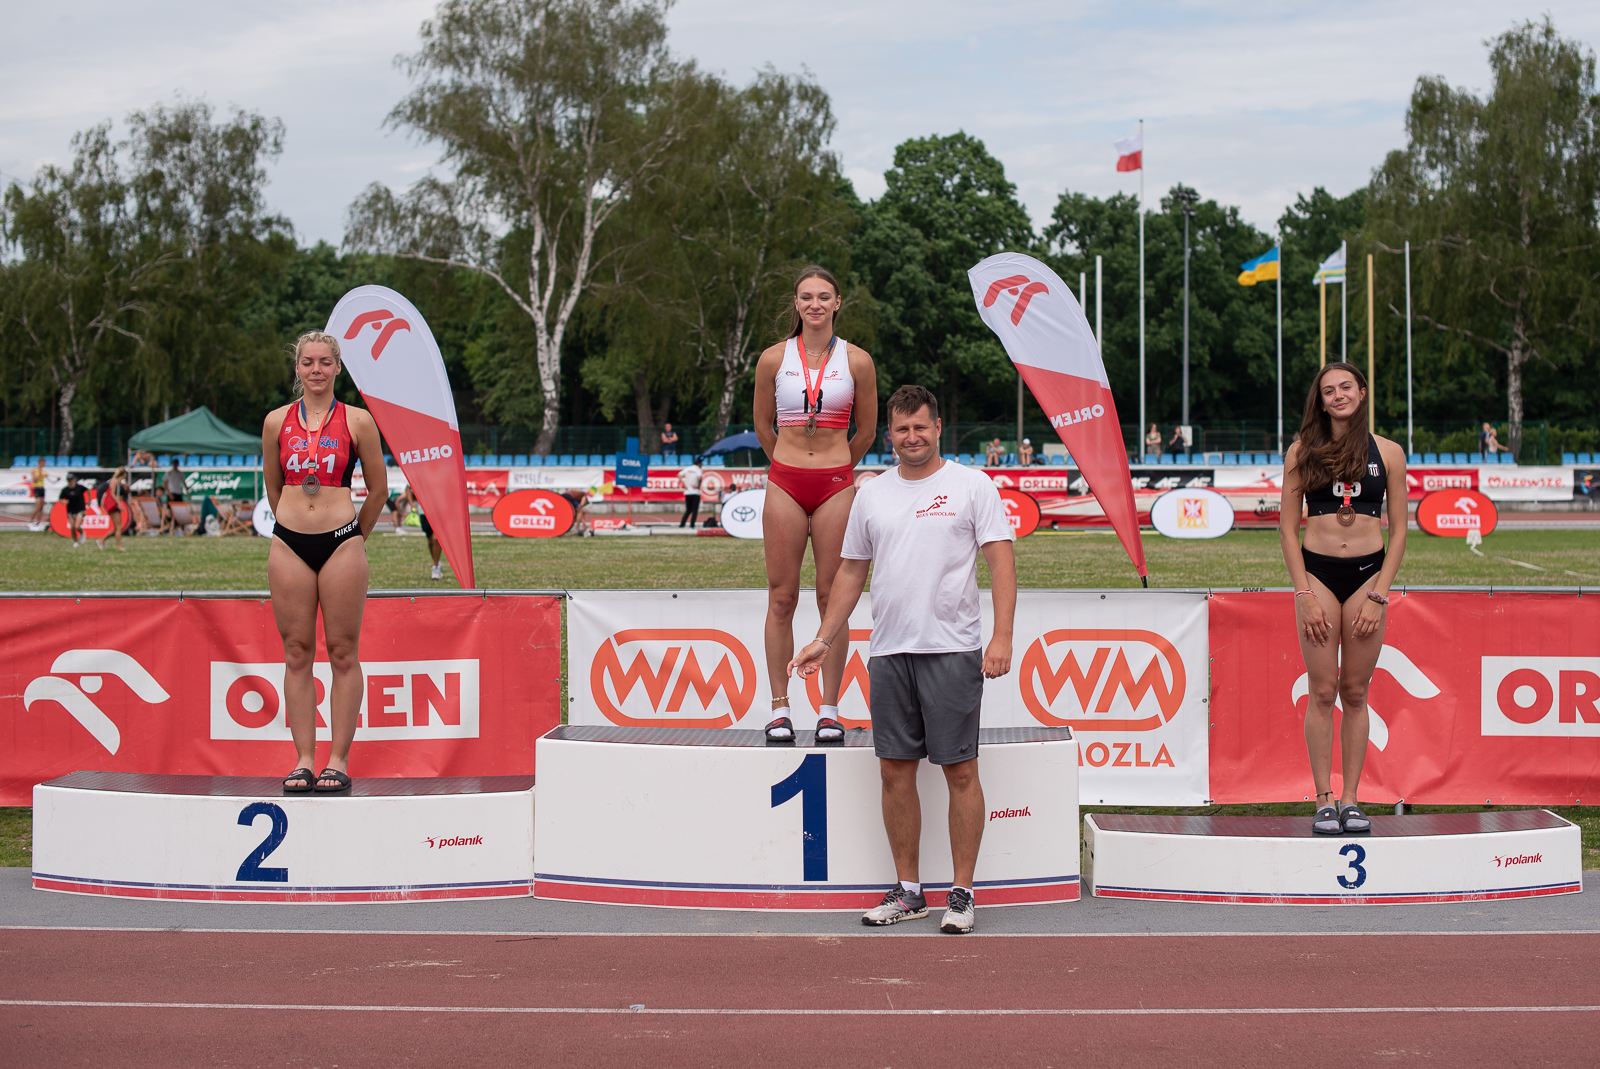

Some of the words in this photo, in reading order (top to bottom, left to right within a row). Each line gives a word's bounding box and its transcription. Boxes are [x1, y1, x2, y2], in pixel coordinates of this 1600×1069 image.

[1023, 480, 1064, 489] ORLEN
[1427, 478, 1467, 488] ORLEN
[513, 517, 551, 527] ORLEN
[1440, 516, 1478, 526] ORLEN
[334, 523, 352, 538] NIKE
[771, 754, 828, 882] 1
[989, 806, 1031, 821] polanik
[235, 802, 289, 882] 2
[438, 834, 483, 849] polanik
[1336, 843, 1367, 889] 3
[1504, 852, 1543, 868] polanik
